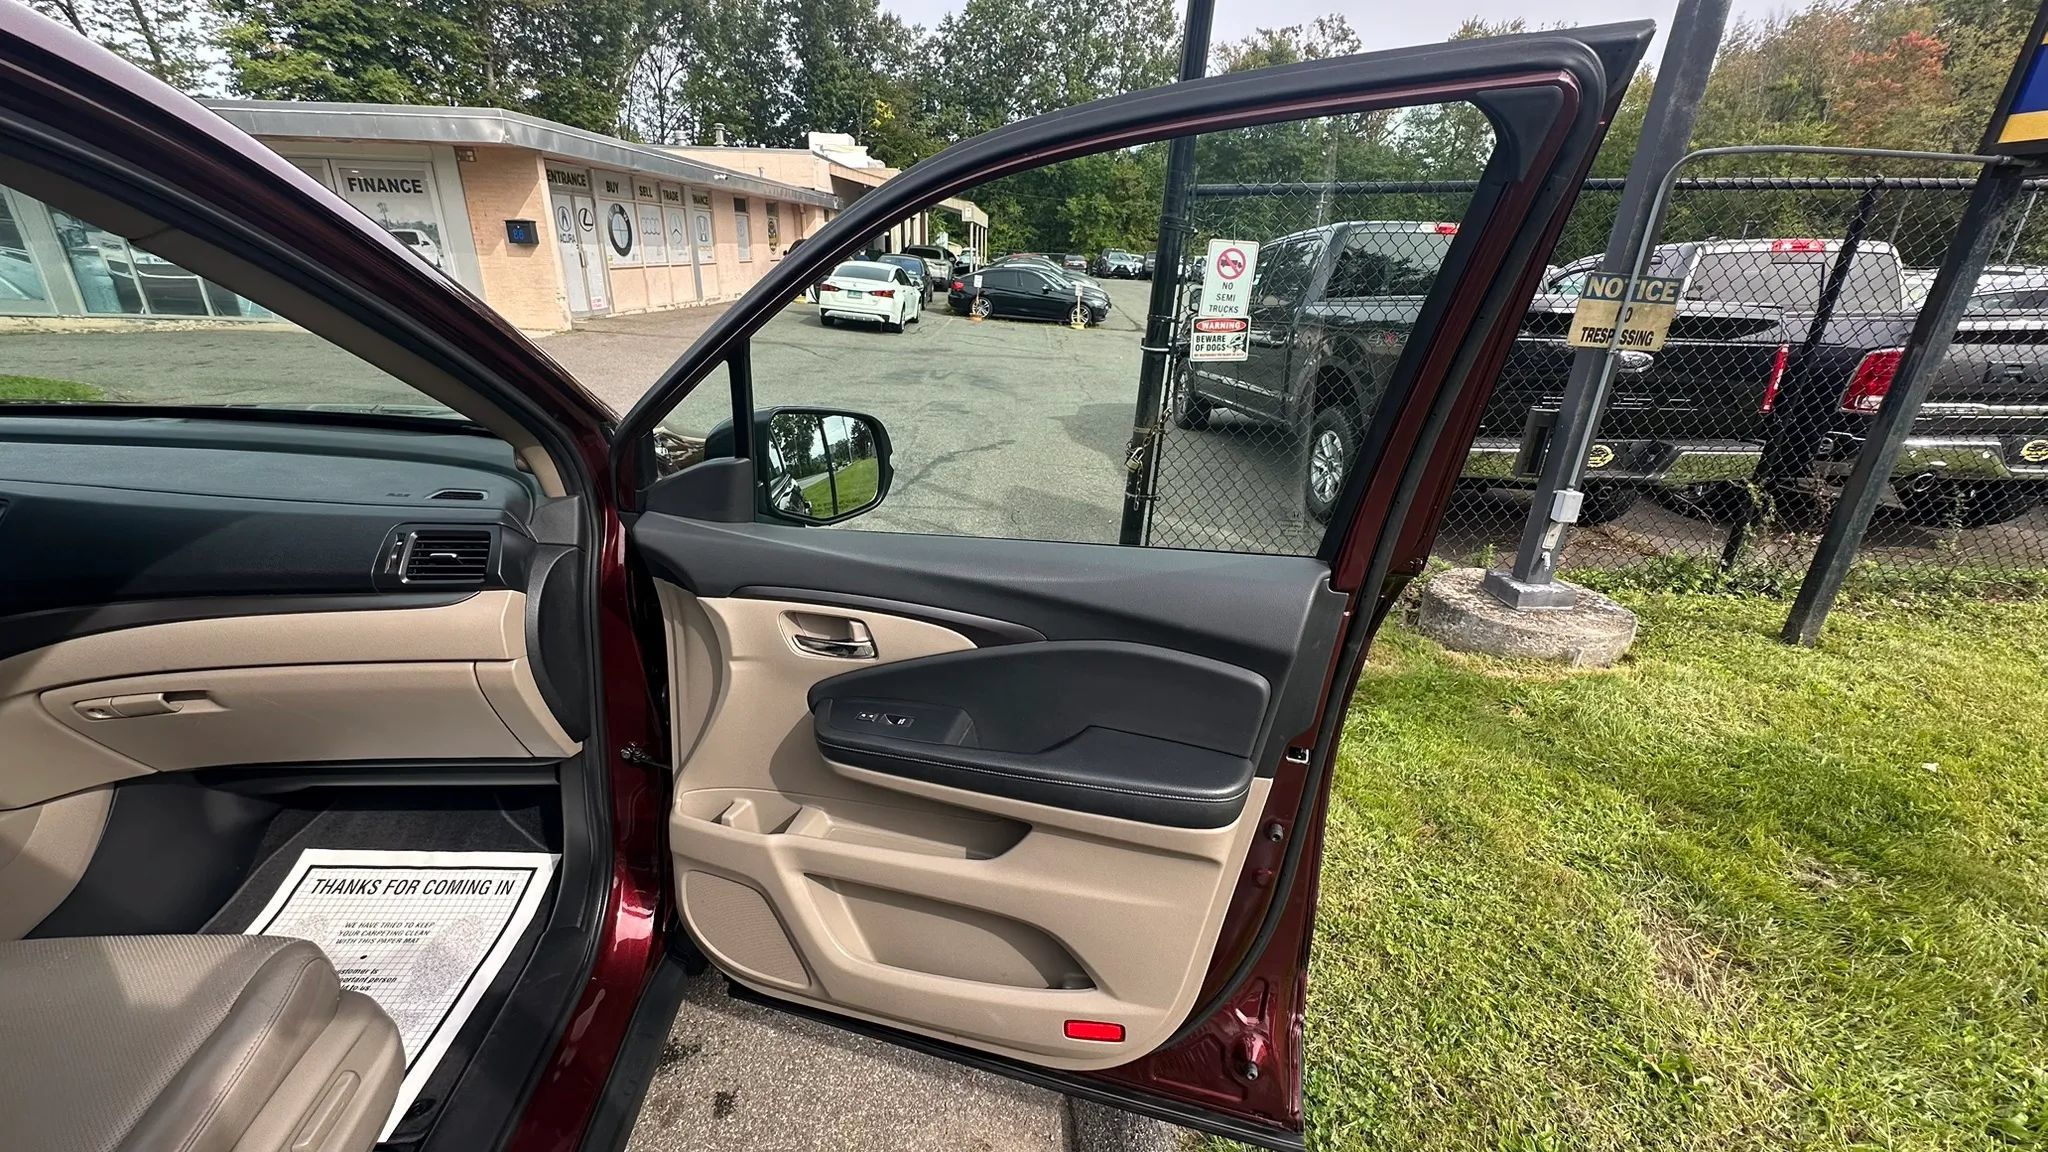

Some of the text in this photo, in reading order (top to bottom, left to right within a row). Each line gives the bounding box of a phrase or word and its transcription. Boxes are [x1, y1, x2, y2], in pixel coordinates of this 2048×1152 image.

[547, 169, 587, 187] ENTRANCE
[348, 177, 423, 193] FINANCE
[606, 180, 619, 194] BUY
[639, 185, 653, 198] SELL
[663, 189, 679, 201] TRADE
[560, 233, 576, 244] ACURA
[1221, 281, 1234, 291] NO
[1585, 276, 1680, 302] NOICE
[1216, 293, 1236, 303] SEMI
[1208, 304, 1239, 314] TRUCKS
[1196, 335, 1226, 343] BEWARE
[1580, 326, 1655, 347] TRESPSSING
[1195, 343, 1226, 352] OF DOGS
[311, 878, 516, 895] THANKS FOR COMING IN
